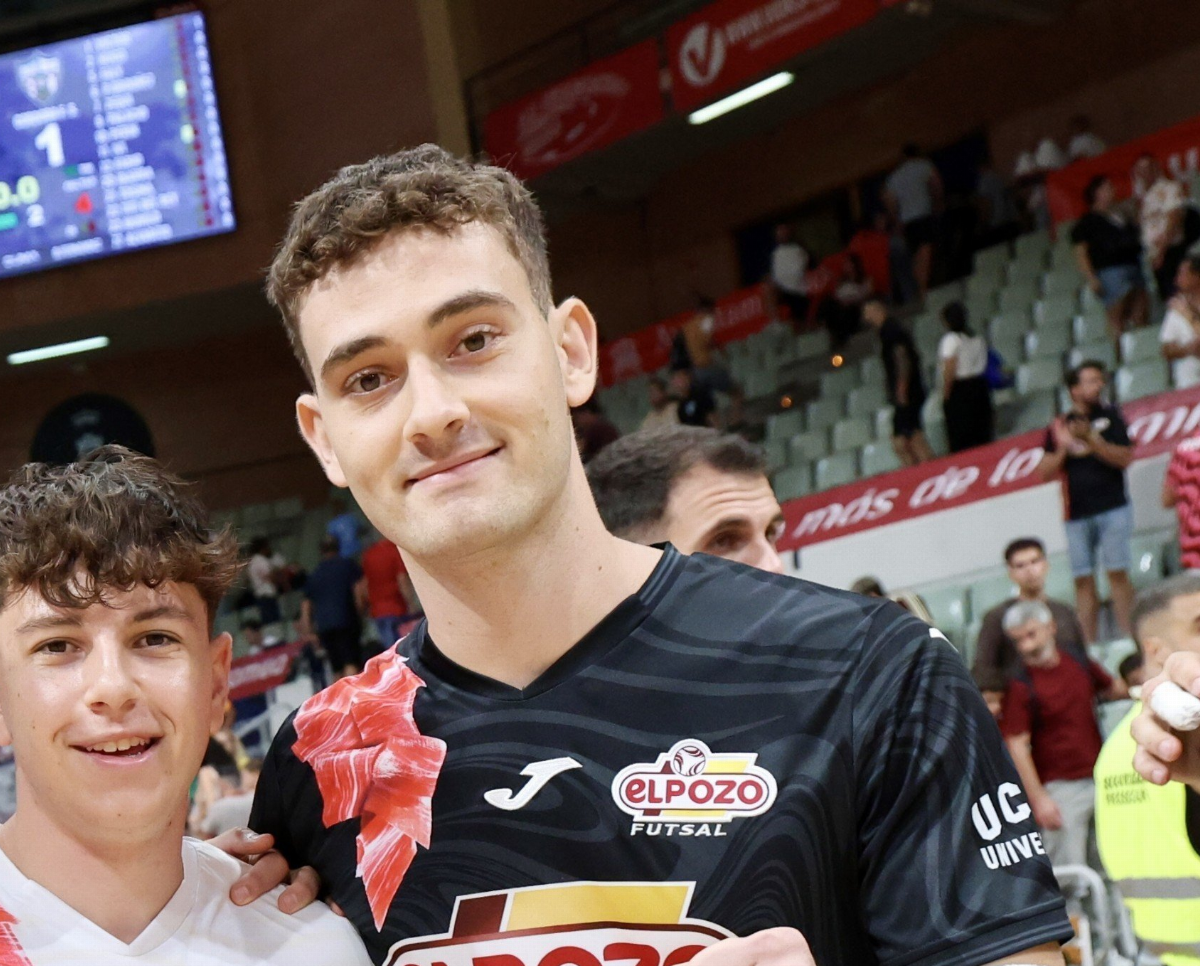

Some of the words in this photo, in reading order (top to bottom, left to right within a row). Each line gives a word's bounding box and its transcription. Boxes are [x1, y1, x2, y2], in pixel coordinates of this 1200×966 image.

[35, 122, 65, 167] 1
[793, 488, 899, 538] más
[909, 466, 980, 508] de
[630, 823, 727, 836] FUTSAL
[980, 832, 1046, 870] UNIVE
